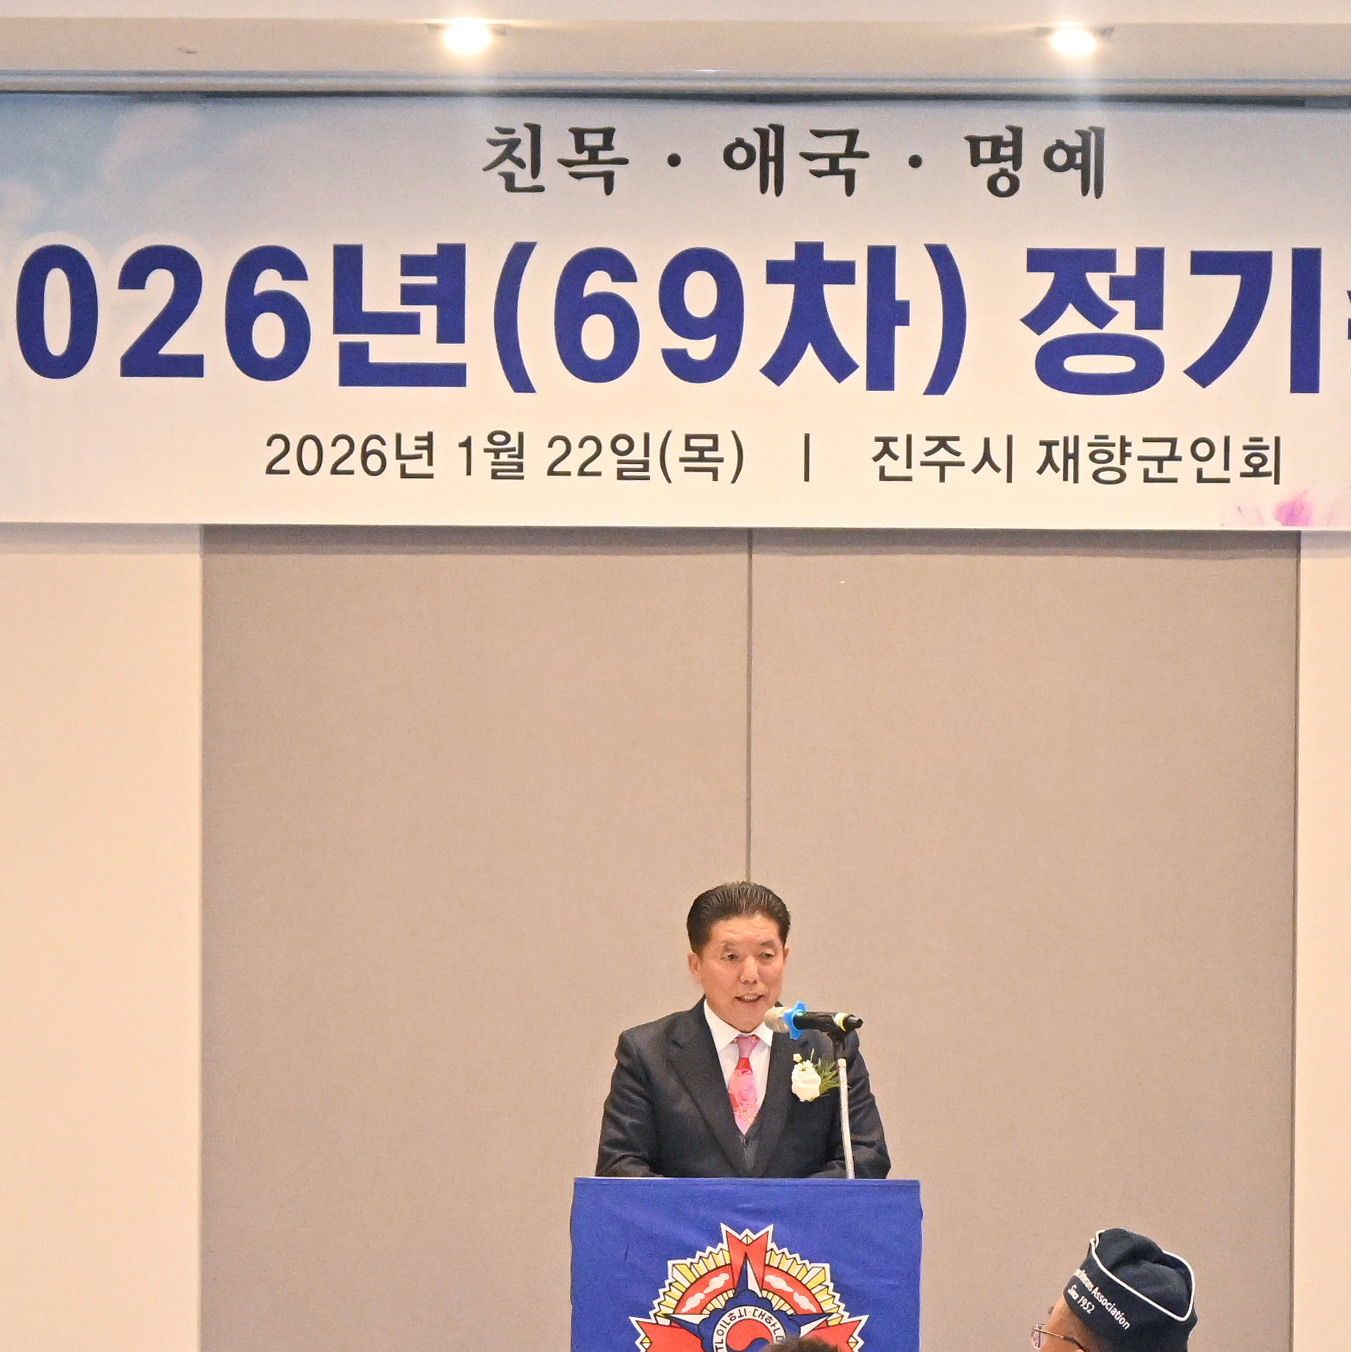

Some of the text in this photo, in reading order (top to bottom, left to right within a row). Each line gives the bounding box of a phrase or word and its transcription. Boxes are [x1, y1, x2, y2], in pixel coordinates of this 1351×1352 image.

[482, 122, 1105, 200] 친목 애국 명예
[265, 430, 1283, 486] 2026년 1월 22일(목) 진주시 재향군인회
[1076, 1294, 1095, 1315] 1952
[1090, 1286, 1131, 1330] Association
